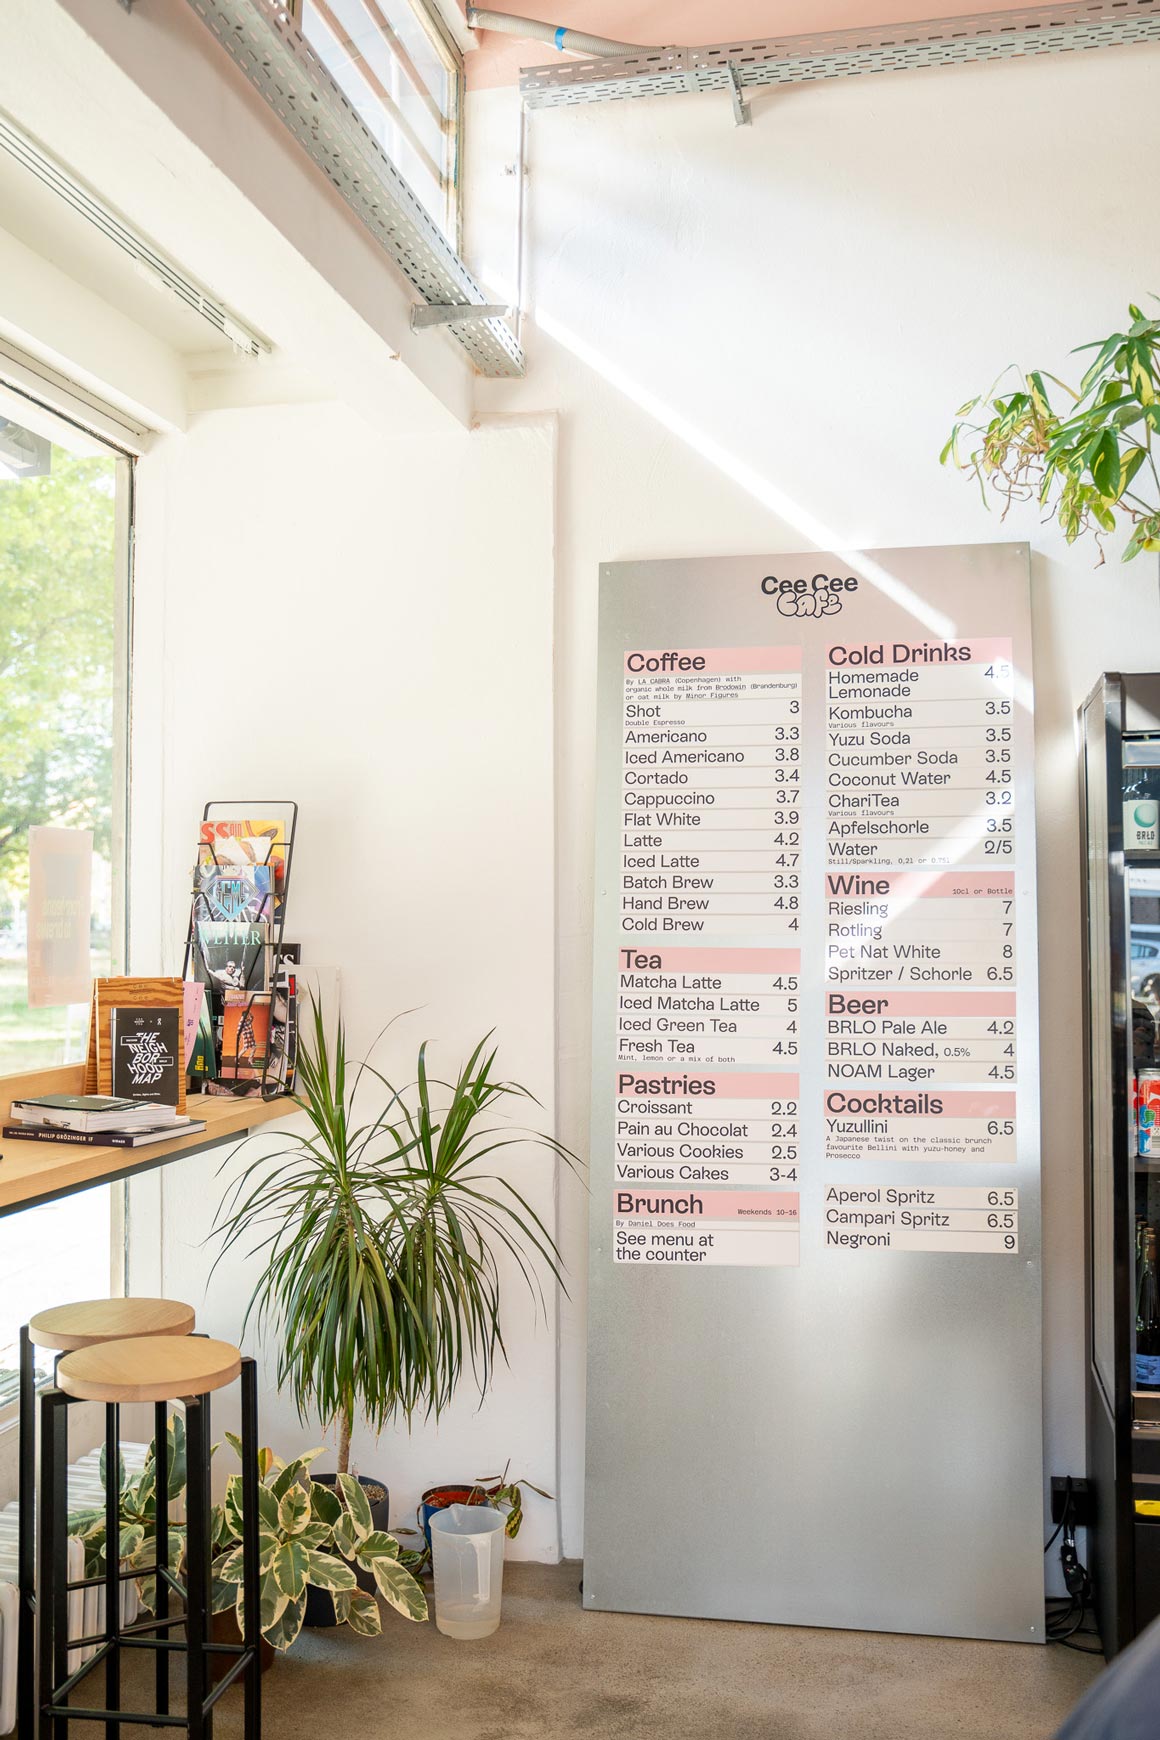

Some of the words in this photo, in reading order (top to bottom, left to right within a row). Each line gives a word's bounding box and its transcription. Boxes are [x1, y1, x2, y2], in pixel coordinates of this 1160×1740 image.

[761, 576, 807, 595] Cee
[811, 574, 858, 592] Cee
[829, 645, 883, 665] Cold
[893, 643, 971, 663] Drinks
[628, 653, 705, 672] Coffee
[829, 669, 919, 684] Homemade
[984, 665, 1010, 679] 4.5
[829, 684, 910, 698] Lemonade
[626, 705, 661, 717] Shot
[790, 701, 799, 713] 3
[829, 705, 912, 720] Kombucha
[986, 702, 1010, 715] 3.5
[625, 730, 707, 743] Americano
[775, 727, 799, 740] 3.3
[829, 733, 864, 746] Yuzu
[870, 732, 910, 745] Soda
[986, 728, 1011, 742] 3.5
[625, 751, 657, 764] Iced
[662, 750, 744, 763] Americano
[775, 748, 799, 761] 3.8
[829, 753, 911, 766] Cucumber
[917, 751, 958, 764] Soda
[986, 749, 1011, 763] 3.5
[625, 771, 688, 784] Cortado
[775, 769, 800, 782] 3.4
[829, 773, 896, 786] Coconut
[901, 772, 951, 785] Water
[986, 770, 1011, 783] 4.5
[624, 792, 714, 808] Cappuccino
[776, 790, 799, 803] 3.7
[829, 794, 899, 807] ChariTea
[986, 791, 1011, 805] 3.2
[624, 813, 651, 826] Flat
[656, 813, 700, 826] White
[774, 812, 799, 824] 3.9
[829, 821, 929, 837] Apfelschorle
[987, 819, 1012, 832] 3.5
[624, 834, 662, 847] Latte
[774, 833, 799, 845] 4.2
[829, 842, 877, 855] Water
[985, 840, 1012, 854] 2/5
[624, 855, 655, 867] Iced
[661, 855, 699, 867] Latte
[776, 854, 799, 866] 4.7
[623, 876, 666, 888] Batch
[673, 876, 713, 888] Brew
[774, 875, 799, 888] 3.3
[828, 875, 889, 895] Wine
[623, 897, 662, 909] Hand
[668, 897, 709, 909] Brew
[774, 897, 798, 909] 4.8
[829, 902, 888, 918] Riesling
[1003, 901, 1012, 914] 7
[622, 918, 657, 931] Cold
[663, 918, 704, 931] Brew
[788, 918, 799, 931] 4
[829, 923, 882, 939] Rotling
[1003, 923, 1012, 936] 7
[621, 950, 662, 969] Tea
[829, 945, 854, 958] Pet
[861, 945, 888, 958] Nat
[893, 945, 940, 958] White
[1003, 945, 1012, 958] 8
[828, 967, 892, 982] Spritzer
[898, 966, 904, 980] /
[910, 967, 972, 980] Schorle
[987, 967, 1013, 980] 6.5
[620, 975, 677, 988] Matcha
[683, 976, 721, 989] Latte
[773, 977, 797, 990] 4.5
[620, 996, 652, 1009] Iced
[658, 997, 714, 1010] Matcha
[721, 998, 759, 1011] Latte
[788, 999, 797, 1012] 5
[829, 994, 888, 1014] Beer
[619, 1017, 651, 1030] Iced
[657, 1018, 704, 1031] Green
[710, 1019, 737, 1032] Tea
[786, 1021, 797, 1033] 4
[828, 1021, 876, 1034] BRLO
[883, 1021, 915, 1034] Pale
[921, 1021, 947, 1034] Ale
[987, 1021, 1014, 1034] 4.2
[619, 1039, 662, 1052] Fresh
[668, 1040, 694, 1053] Tea
[772, 1042, 797, 1055] 4.5
[828, 1043, 876, 1056] BRLO
[883, 1043, 938, 1059] Naked,
[944, 1047, 970, 1057] 0.5%
[1004, 1043, 1014, 1056] 4
[133, 1053, 160, 1063] BOR
[127, 1063, 163, 1074] HOOD
[828, 1064, 881, 1078] NOAM
[888, 1065, 934, 1081] Lager
[988, 1066, 1014, 1079] 4.5
[132, 1073, 162, 1084] MAP
[619, 1074, 716, 1095] Pastries
[618, 1100, 692, 1114] Croissant
[771, 1102, 797, 1115] 2.2
[827, 1093, 943, 1113] Cocktails
[618, 1122, 649, 1135] Pain
[655, 1125, 672, 1135] au
[678, 1122, 748, 1137] Chocolat
[771, 1123, 797, 1137] 2.4
[827, 1119, 888, 1133] Yuzullini
[988, 1121, 1014, 1135] 6.5
[617, 1143, 674, 1157] Various
[679, 1144, 743, 1158] Cookies
[771, 1146, 797, 1159] 2.5
[617, 1165, 674, 1179] Various
[679, 1166, 728, 1180] Cakes
[770, 1168, 797, 1181] 3-4
[618, 1193, 703, 1213] Brunch
[827, 1188, 880, 1204] Aperol
[887, 1189, 934, 1206] Spritz
[988, 1192, 1014, 1205] 6.5
[827, 1209, 895, 1227] Campari
[901, 1212, 949, 1228] Spritz
[988, 1214, 1014, 1228] 6.5
[616, 1231, 646, 1245] See
[652, 1235, 693, 1246] menu
[699, 1234, 714, 1246] at
[827, 1231, 890, 1248] Negroni
[1005, 1235, 1015, 1249] 9
[616, 1247, 640, 1260] the
[646, 1250, 706, 1261] counter
